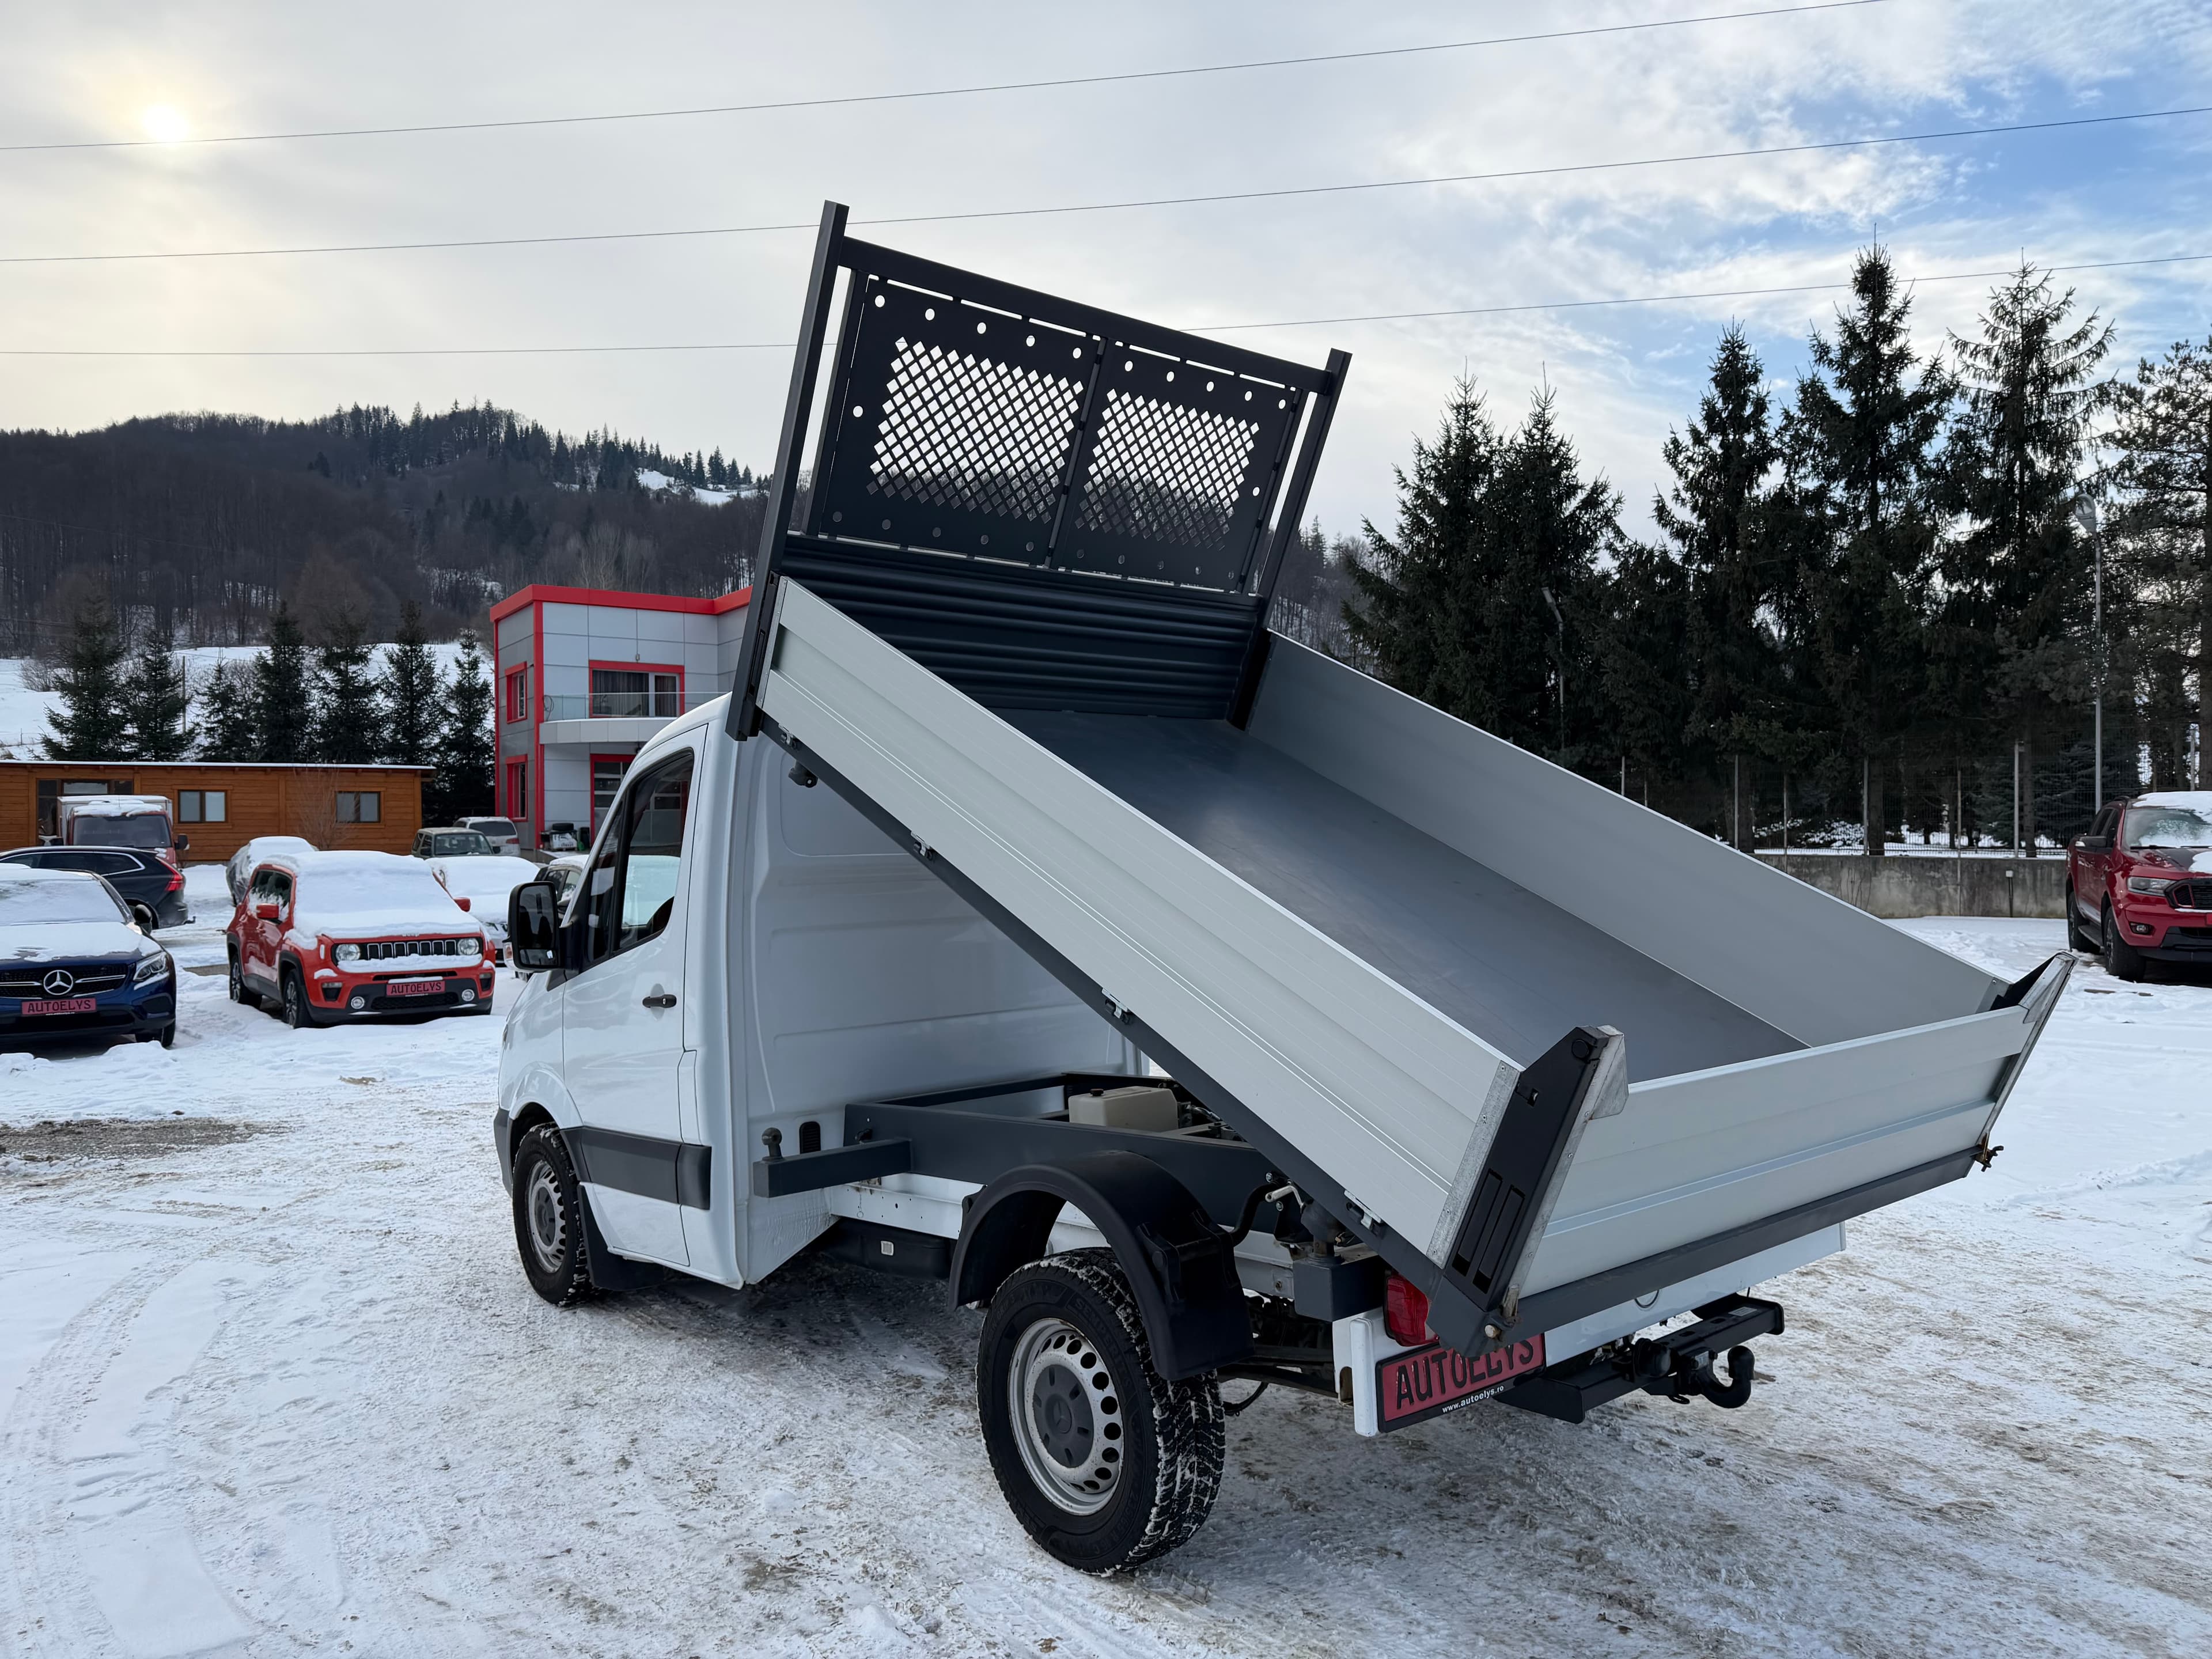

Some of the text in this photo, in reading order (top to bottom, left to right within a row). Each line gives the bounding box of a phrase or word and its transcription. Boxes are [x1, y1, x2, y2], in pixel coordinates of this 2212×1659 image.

[391, 982, 441, 994] AUTOELYS
[27, 999, 91, 1013] AUTOELYS
[1396, 1340, 1533, 1410] AUTOELYS
[1442, 1385, 1504, 1413] www.autoelys.ro
